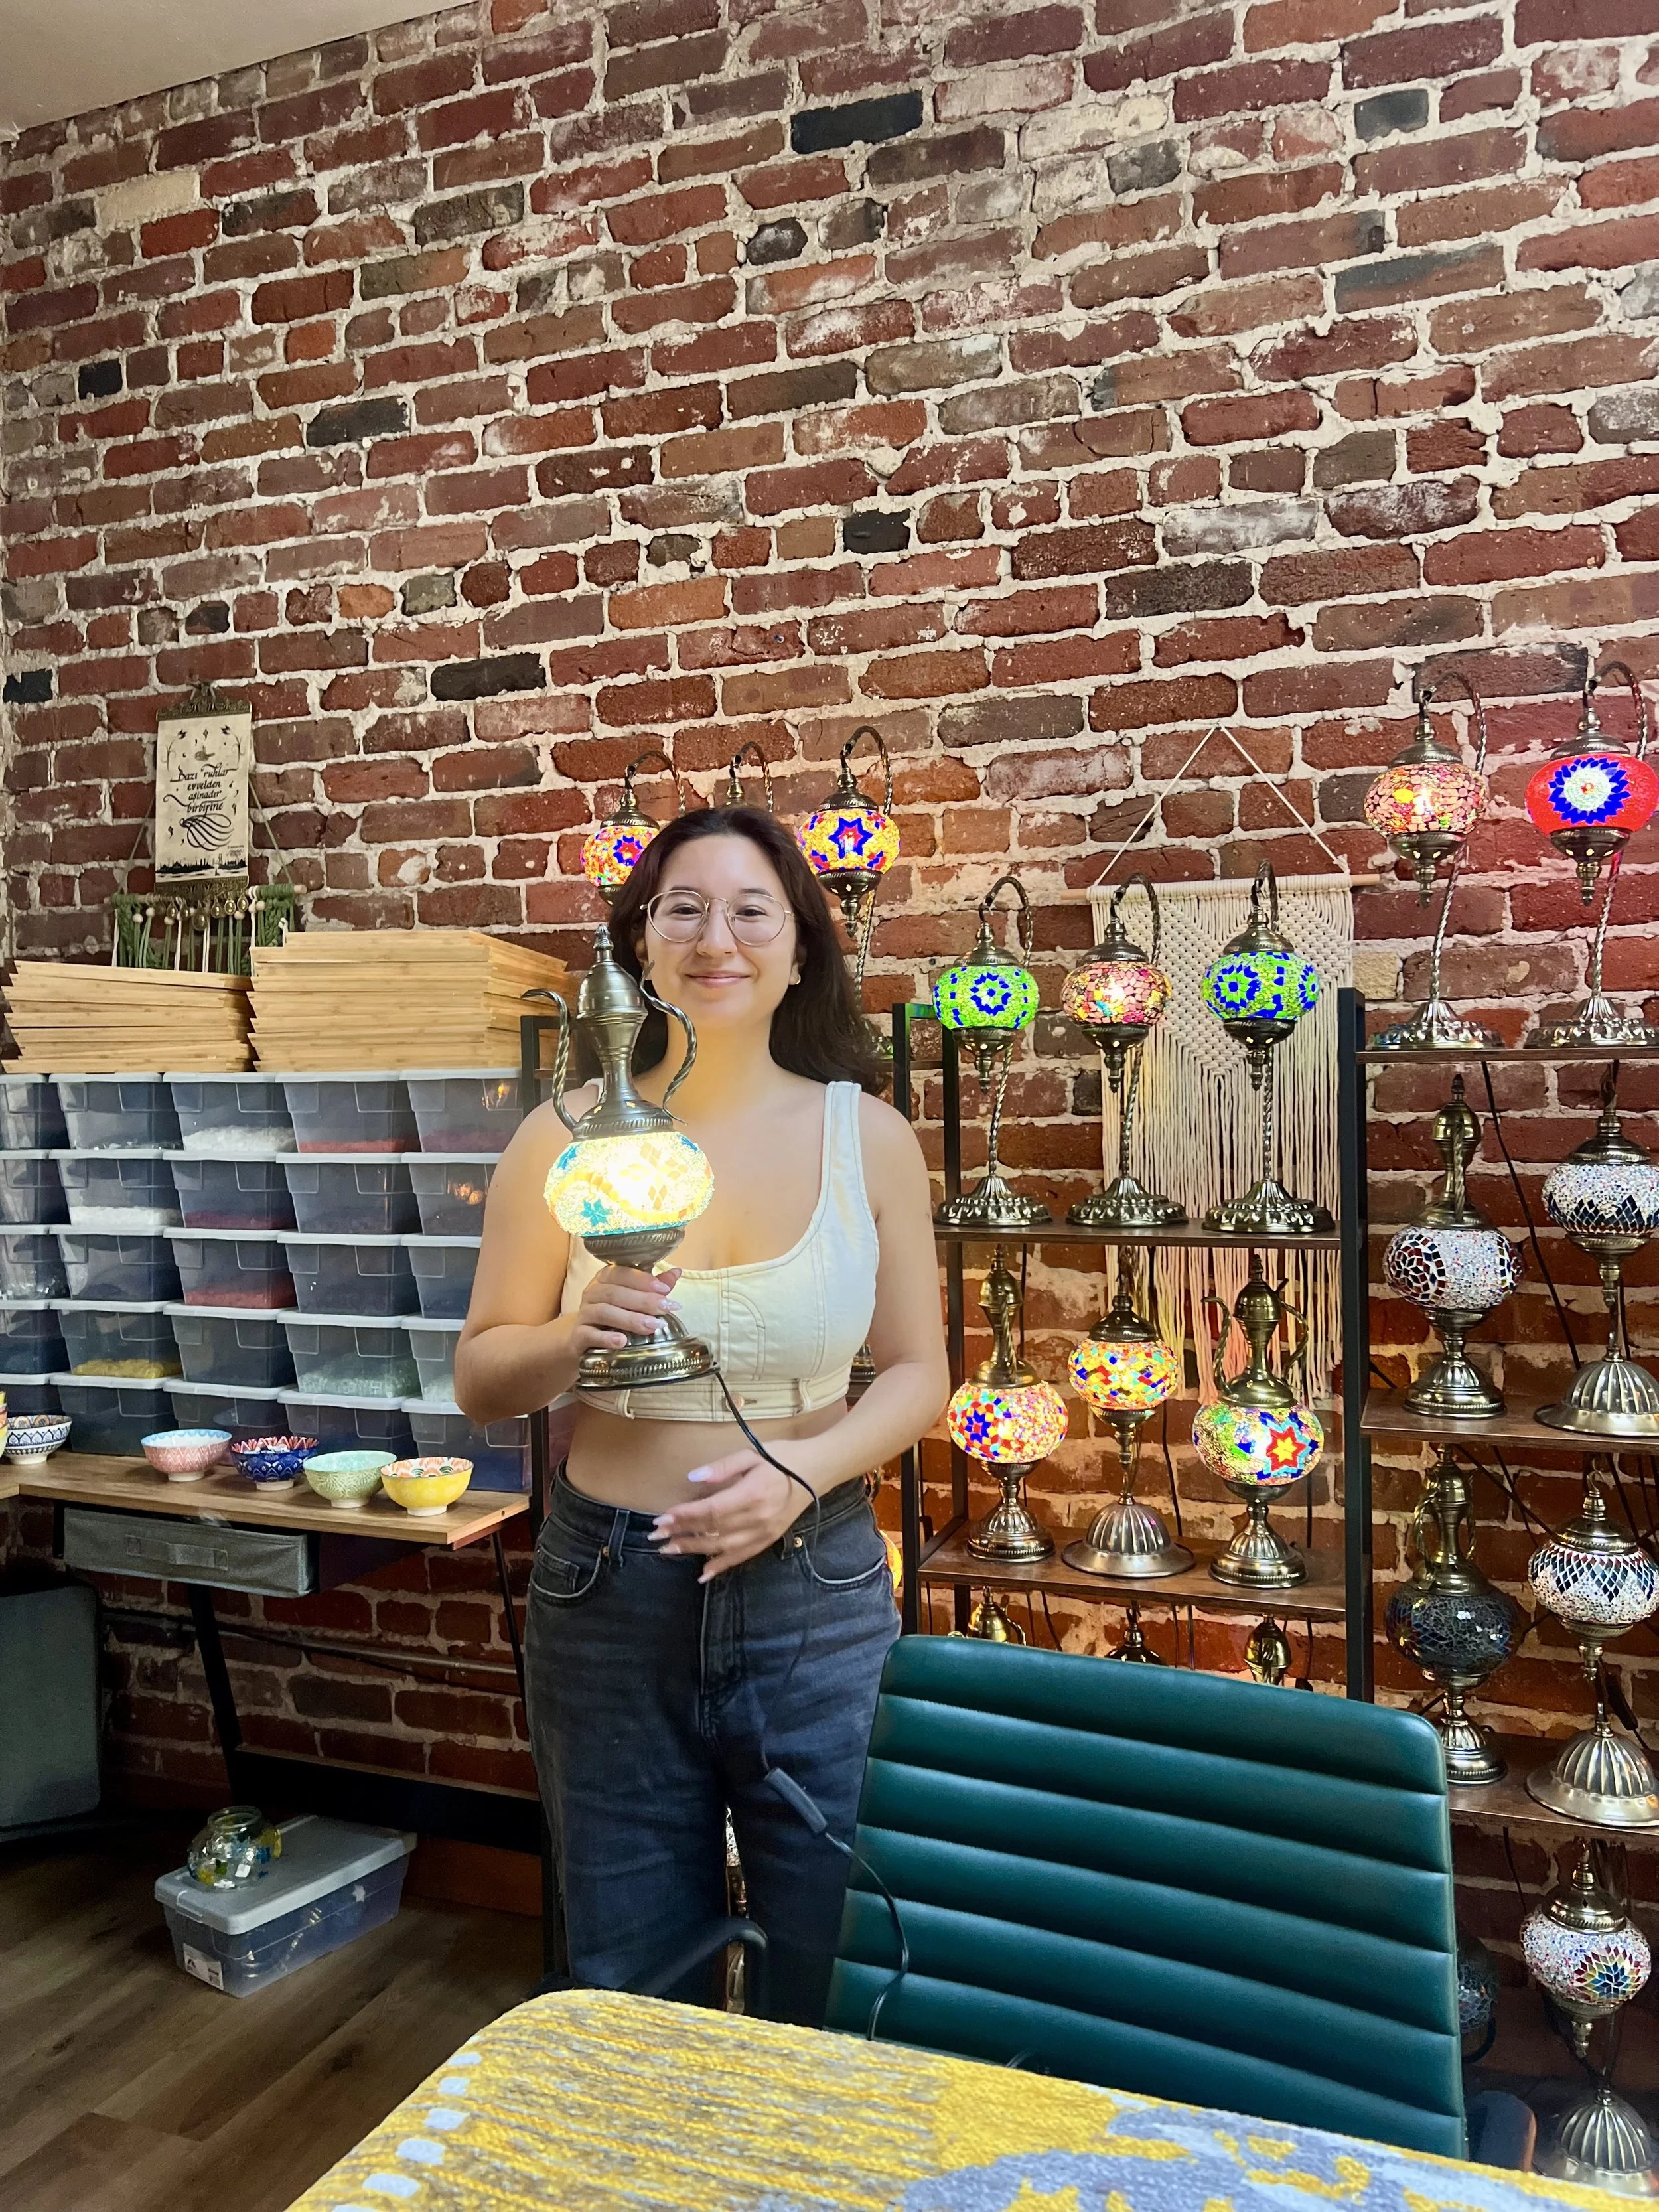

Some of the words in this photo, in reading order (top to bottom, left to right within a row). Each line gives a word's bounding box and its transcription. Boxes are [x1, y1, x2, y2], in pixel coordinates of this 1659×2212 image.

[171, 765, 198, 782] Bazı
[202, 763, 236, 778] ruhlar
[187, 780, 221, 791] evvelden
[186, 800, 224, 814] birbirine
